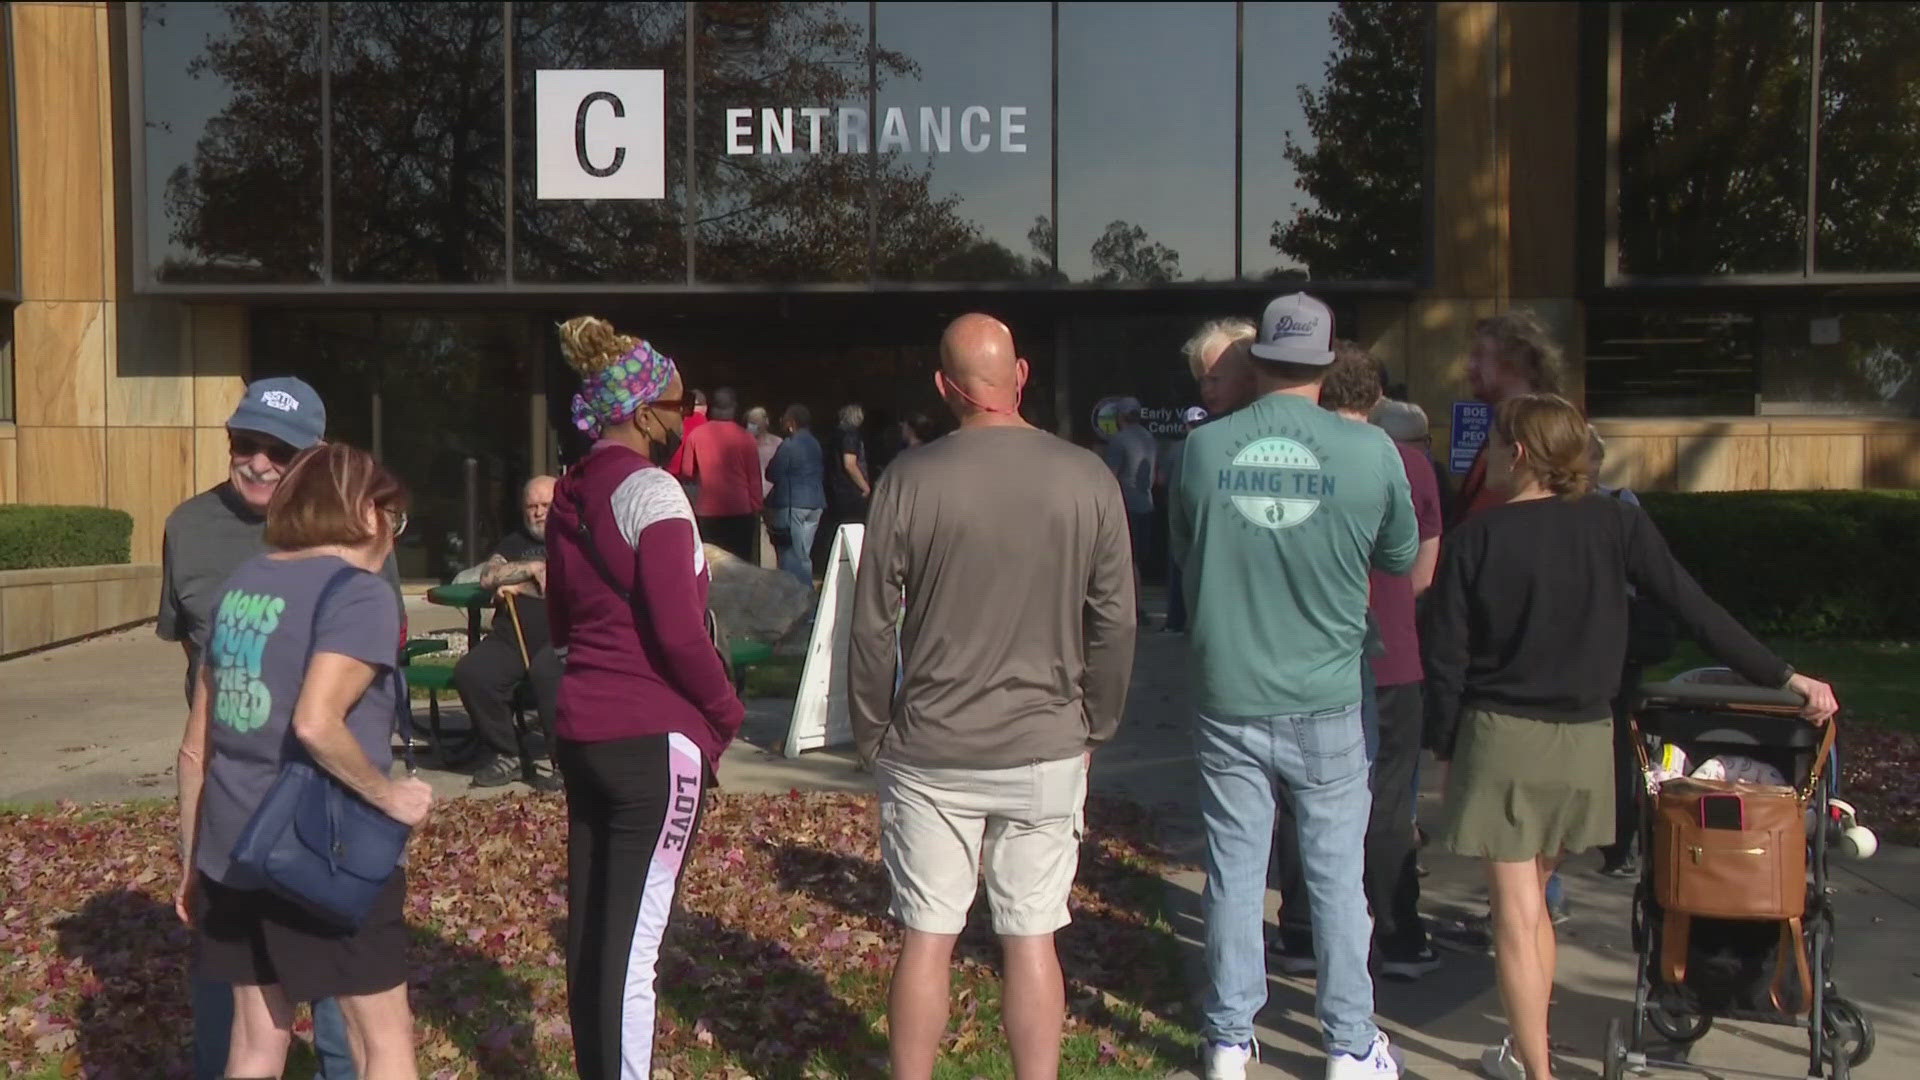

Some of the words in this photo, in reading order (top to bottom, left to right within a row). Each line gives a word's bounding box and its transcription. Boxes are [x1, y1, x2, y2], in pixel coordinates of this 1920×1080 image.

[575, 91, 627, 178] C
[725, 106, 1028, 155] ENTRANCE
[1140, 407, 1173, 422] Early
[1462, 407, 1488, 417] BOE
[1217, 468, 1283, 493] HANG
[1292, 472, 1337, 497] TEN
[215, 589, 286, 635] MOMS
[215, 679, 272, 733] ORLD
[662, 774, 698, 853] LOVE
